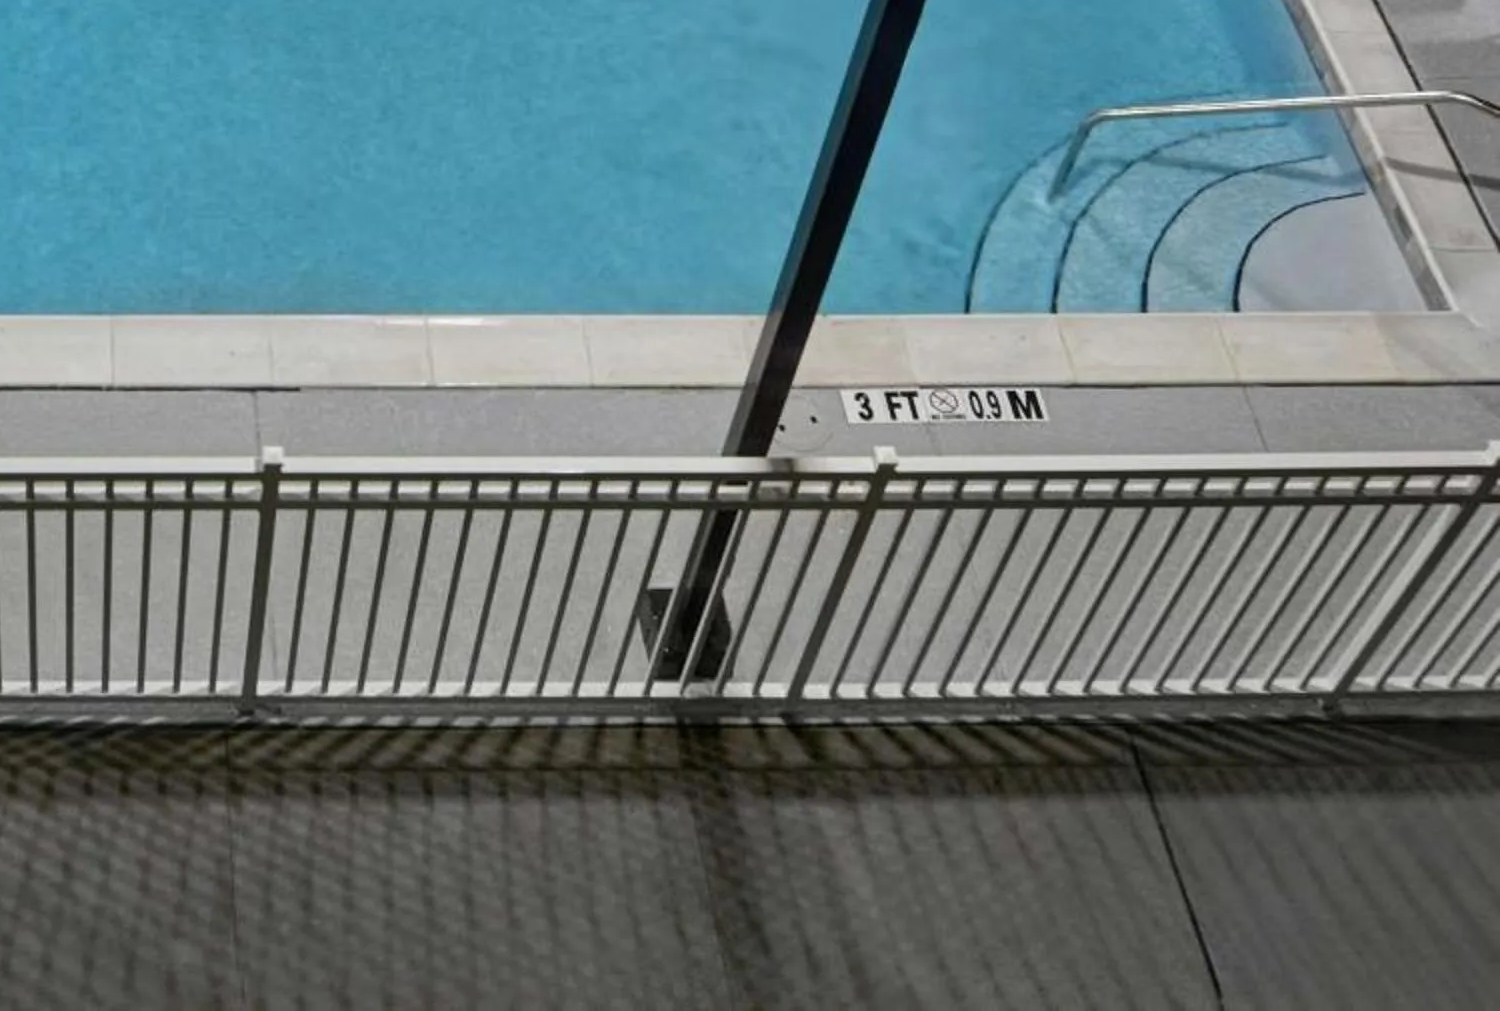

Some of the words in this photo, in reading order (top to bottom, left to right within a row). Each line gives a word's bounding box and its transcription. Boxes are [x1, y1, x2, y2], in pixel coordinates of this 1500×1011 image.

[854, 392, 874, 421] 3
[884, 391, 920, 420] FT
[968, 390, 1002, 420] 0.9
[1005, 390, 1045, 419] M
